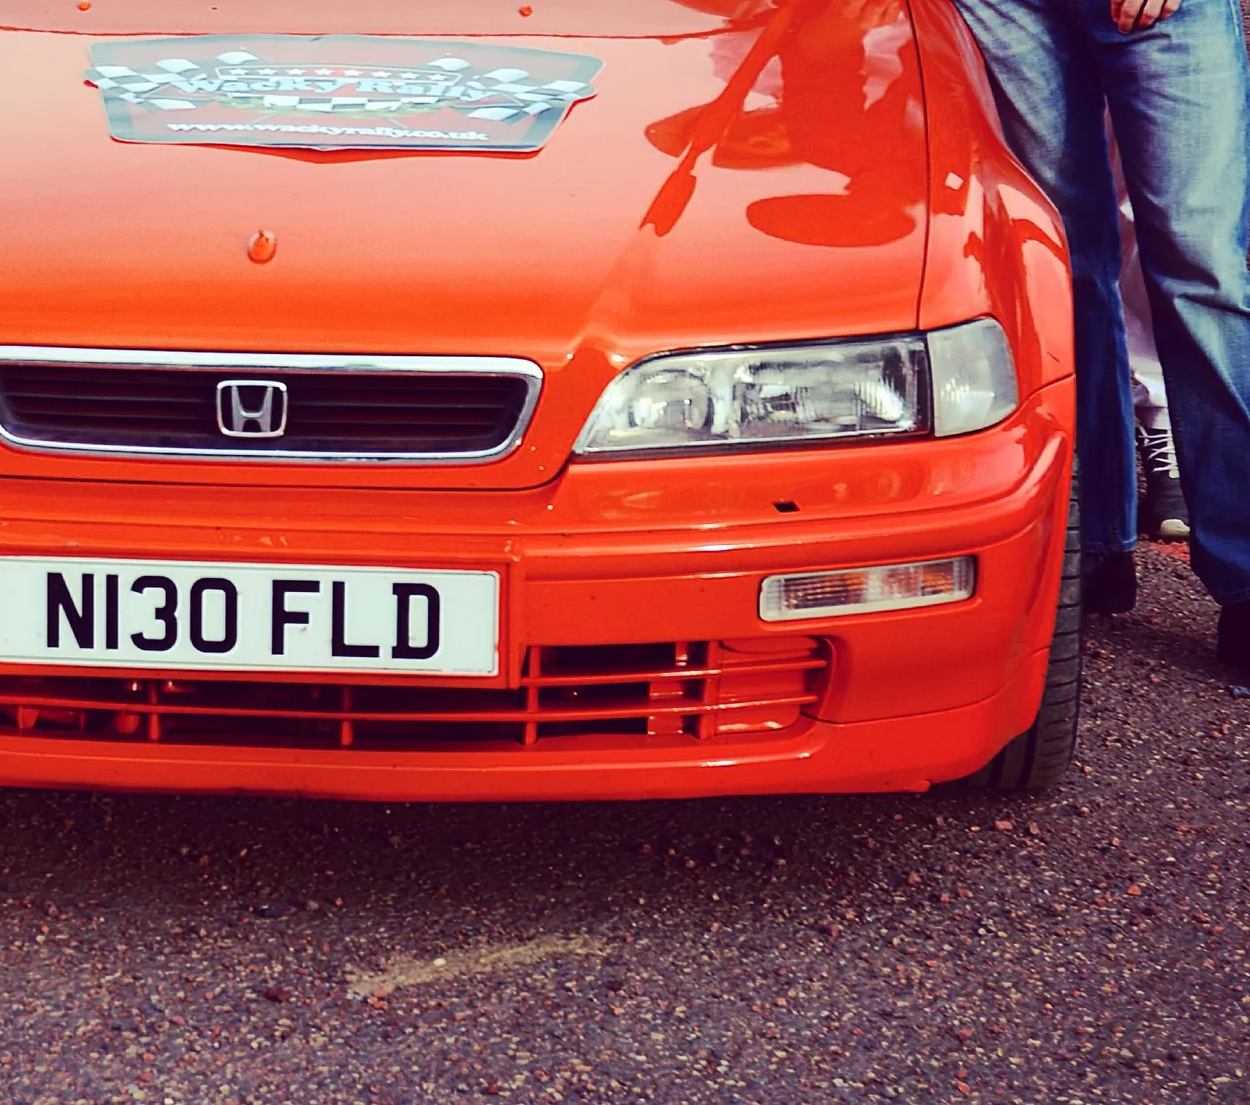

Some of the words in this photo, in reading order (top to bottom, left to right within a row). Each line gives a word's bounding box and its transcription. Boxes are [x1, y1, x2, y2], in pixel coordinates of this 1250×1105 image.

[355, 79, 498, 102] Rally
[166, 123, 490, 141] www.wackyrally.co.uk
[271, 579, 441, 661] FLD
